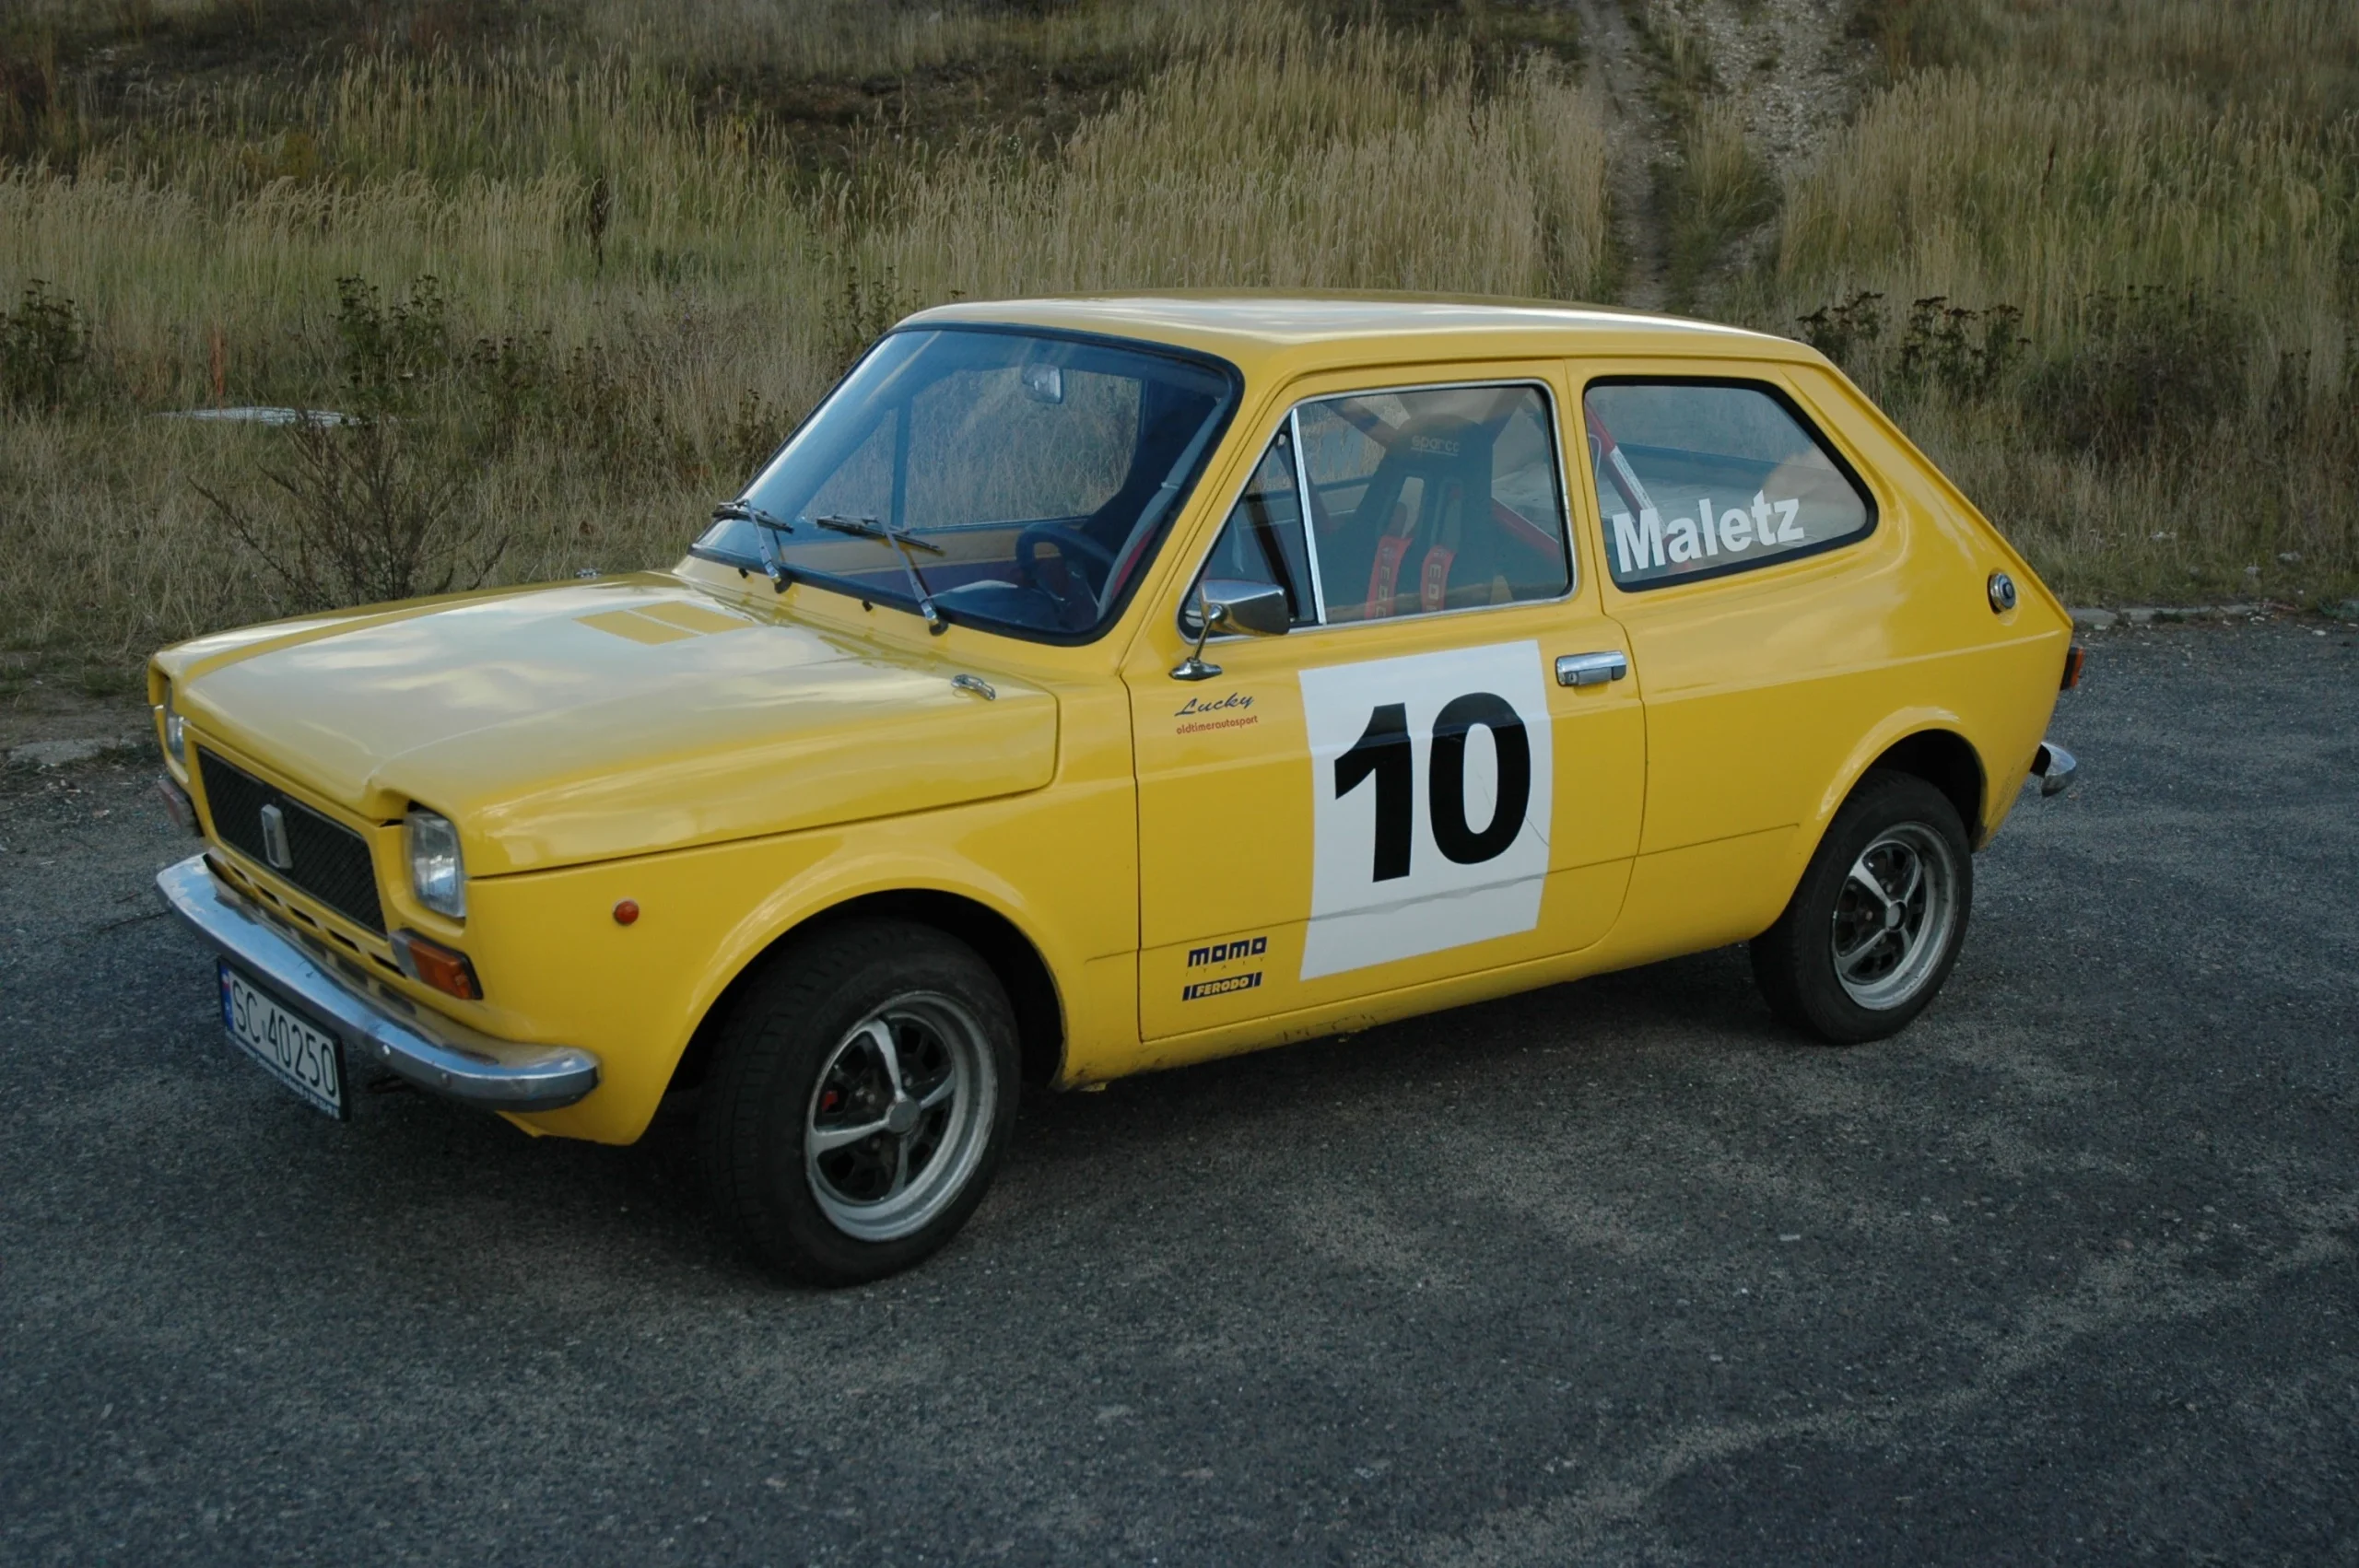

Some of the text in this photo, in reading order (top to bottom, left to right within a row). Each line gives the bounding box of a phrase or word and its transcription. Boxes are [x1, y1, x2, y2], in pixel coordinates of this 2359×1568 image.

[1613, 490, 1804, 573] Maletz
[1174, 692, 1255, 717] Lucky
[1176, 715, 1259, 735] oldtimerautosport
[1334, 692, 1531, 883] 10
[1195, 977, 1250, 998] FERODO
[232, 979, 261, 1044] SC
[267, 1008, 336, 1099] 40250
